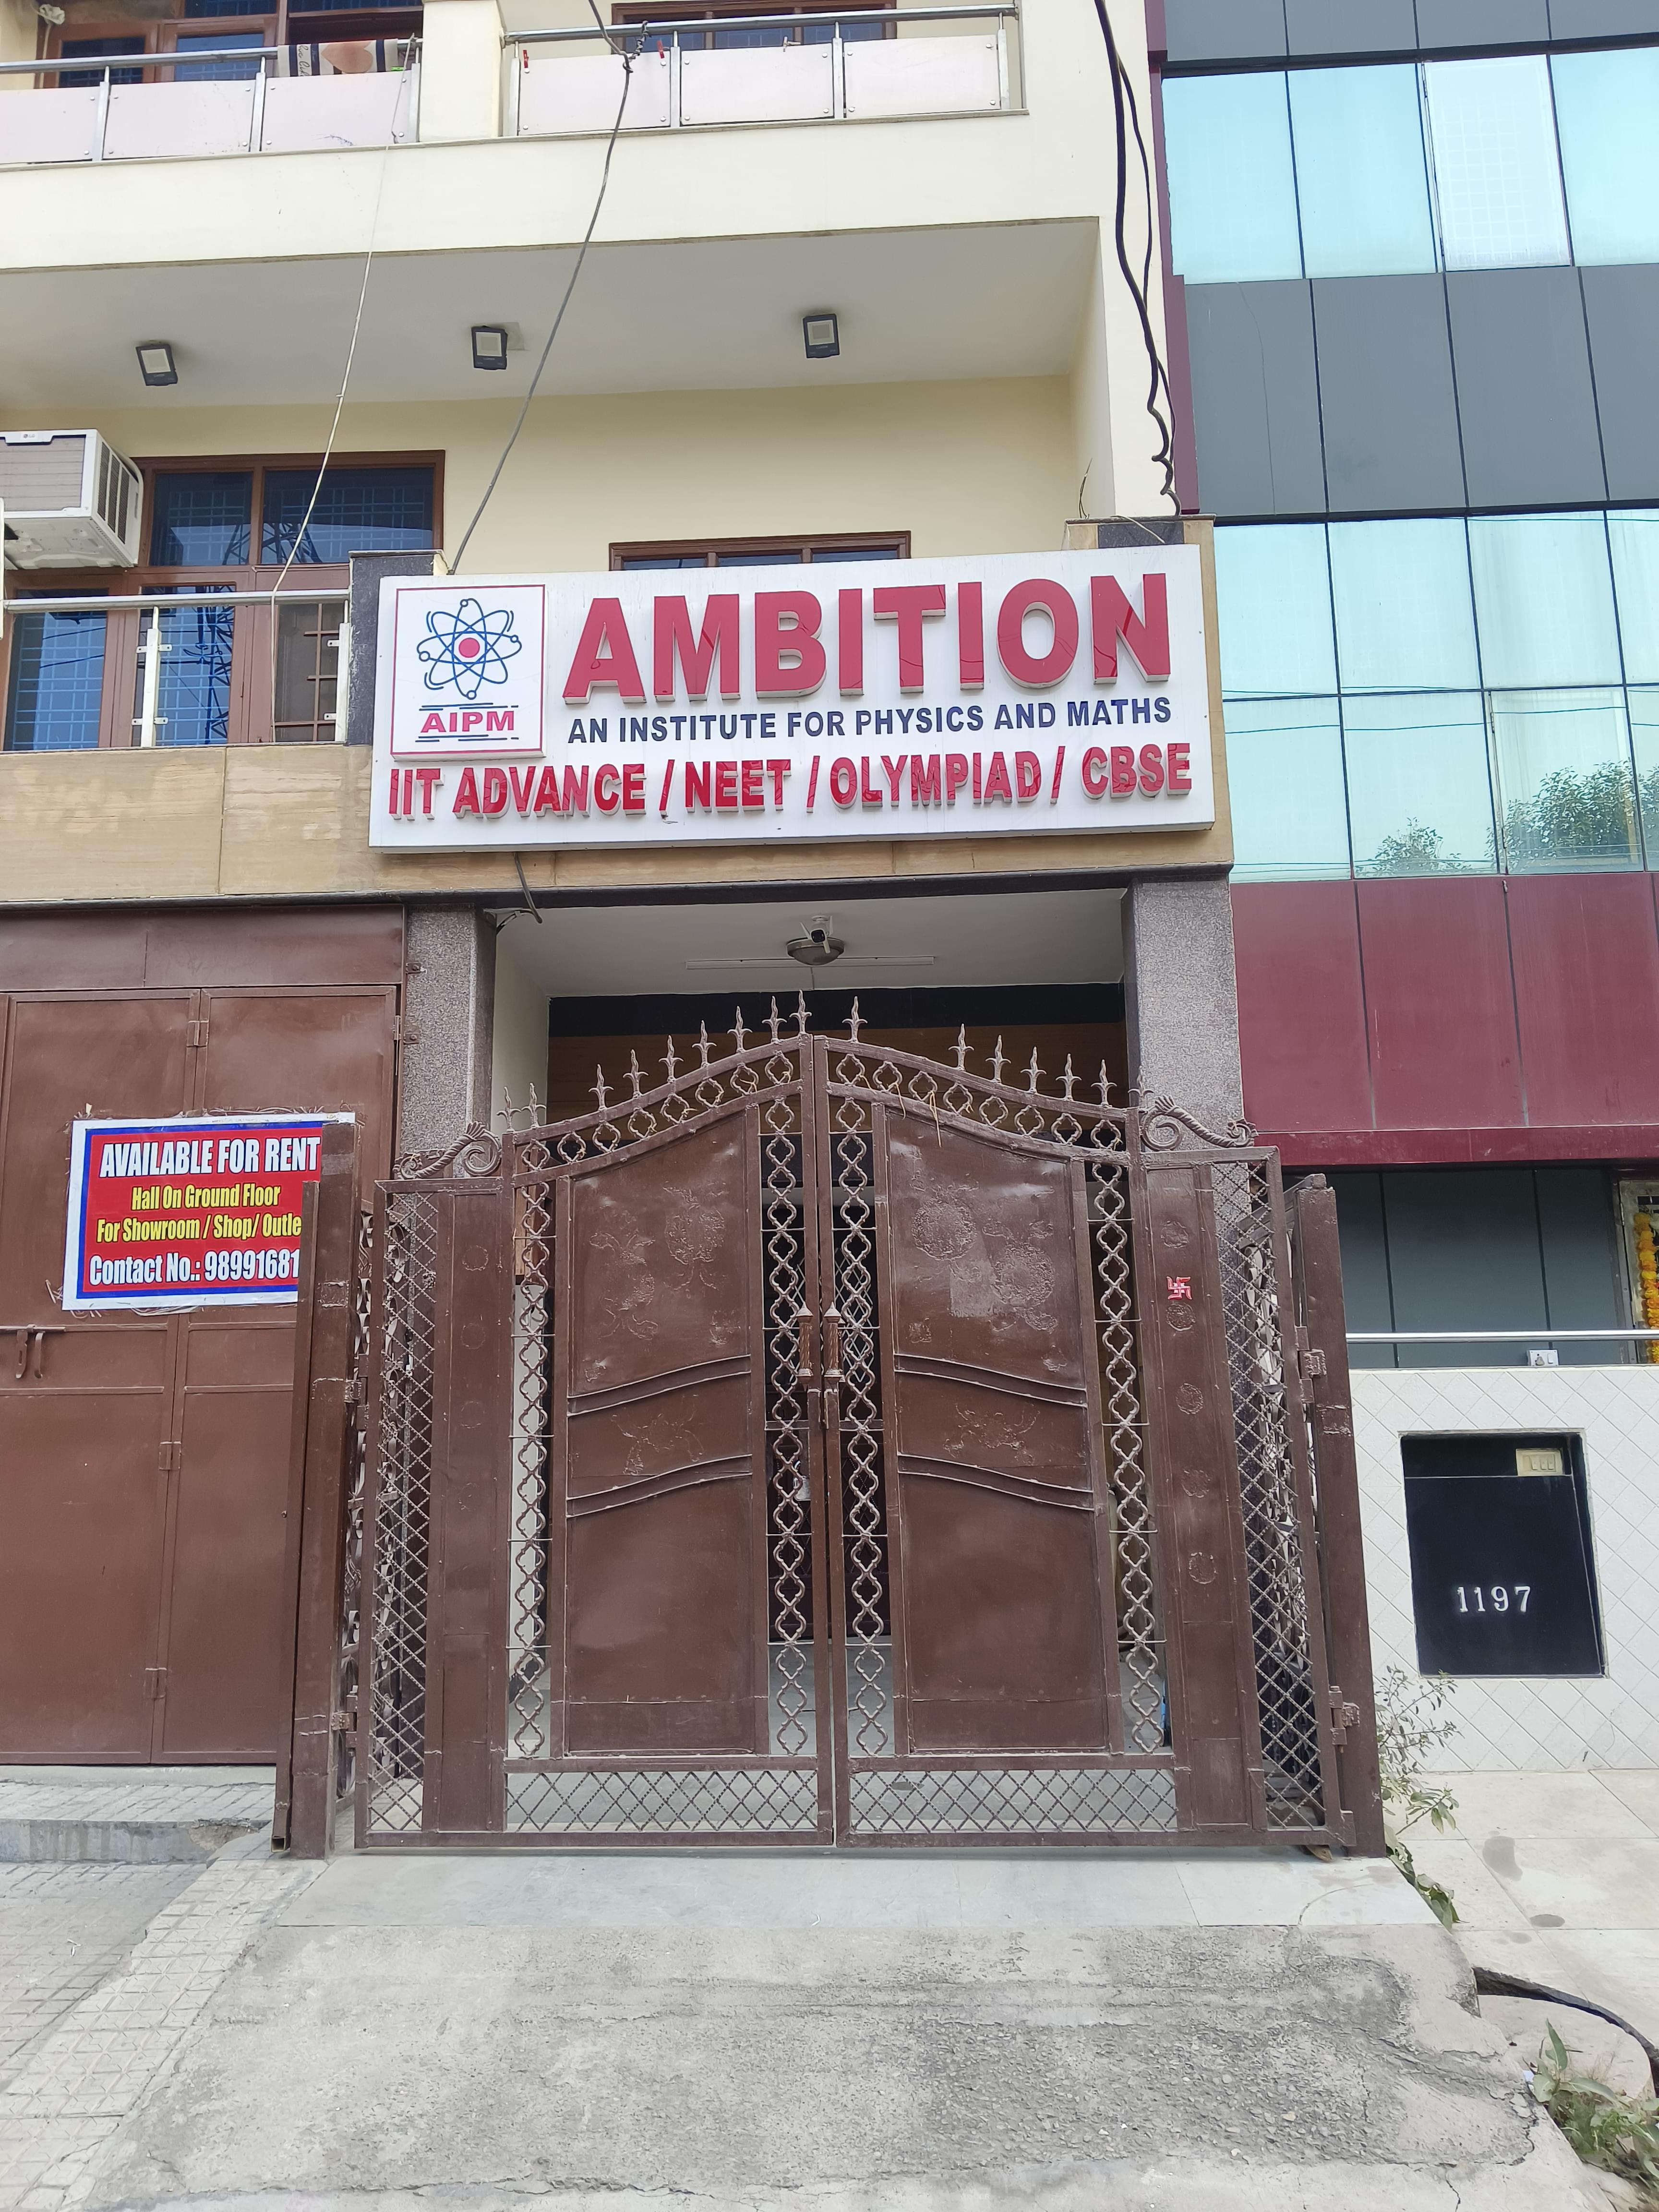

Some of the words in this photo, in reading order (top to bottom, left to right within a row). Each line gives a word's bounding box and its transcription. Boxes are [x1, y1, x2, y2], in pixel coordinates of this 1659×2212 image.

[562, 573, 1171, 703] AMBITION
[421, 710, 514, 733] AIPM
[568, 718, 608, 744] AN
[620, 713, 776, 742] INSTITUTE
[788, 710, 844, 737] FOR
[855, 705, 984, 735] PHYSICS
[994, 702, 1057, 730] AND
[1067, 697, 1172, 727] MATHS
[389, 768, 443, 819] IIT
[452, 763, 646, 818] ADVANCE
[659, 759, 675, 812] /
[685, 758, 791, 812] NEET
[806, 755, 820, 812] /
[830, 750, 1042, 809] OLYMPIAD
[1050, 745, 1066, 804] /
[1082, 743, 1192, 799] CBSE
[99, 1140, 213, 1178] AVAILABLE
[217, 1138, 260, 1173] FOR
[264, 1136, 321, 1171] RENT
[131, 1186, 160, 1211] Hall
[163, 1184, 182, 1209] On
[185, 1184, 240, 1208] Ground
[242, 1183, 281, 1207] Floor
[97, 1218, 120, 1242] For
[122, 1217, 200, 1242] Showroom
[262, 1212, 302, 1238] Outle
[89, 1254, 163, 1286] Contact
[166, 1252, 201, 1282] No.:
[204, 1248, 300, 1282] 98991681
[1456, 1586, 1531, 1613] 1197
